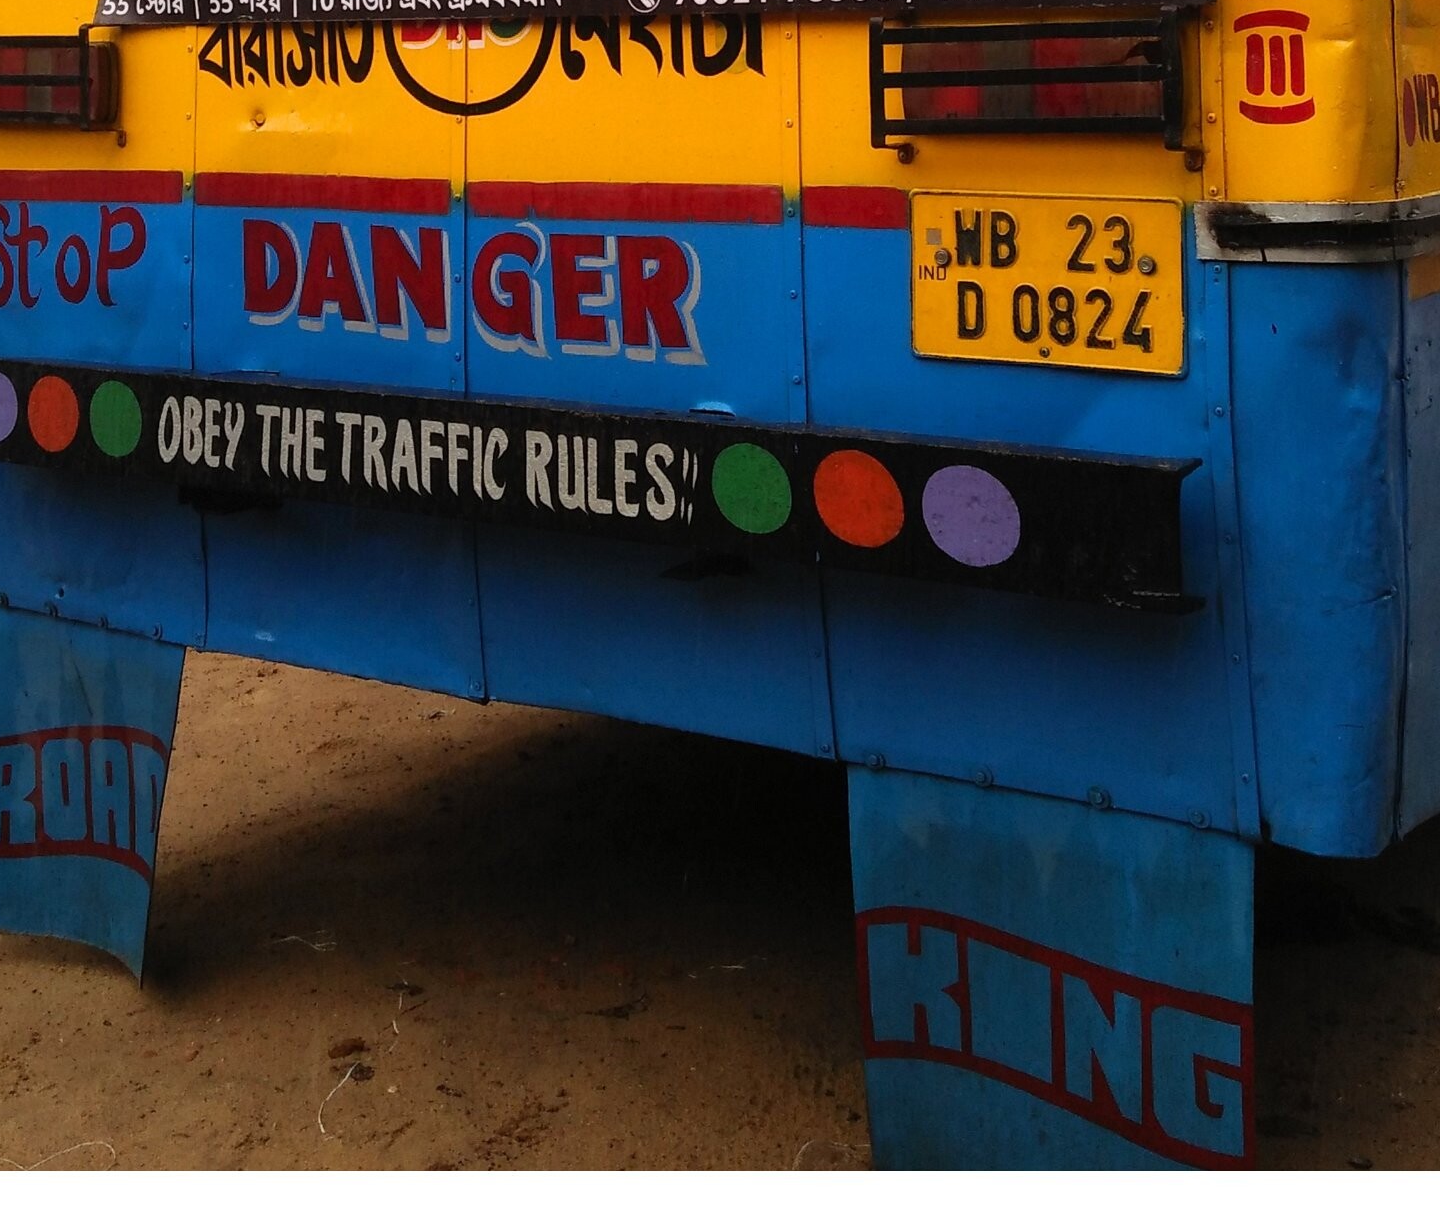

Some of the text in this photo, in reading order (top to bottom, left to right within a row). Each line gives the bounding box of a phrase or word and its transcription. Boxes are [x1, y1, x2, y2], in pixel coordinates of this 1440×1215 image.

[242, 219, 706, 364] DANGER
[954, 209, 1134, 274] WB 23
[957, 281, 1153, 353] D 0824
[158, 396, 244, 471] OBEY
[256, 404, 326, 482] THE
[335, 412, 509, 501] TRAFFIC
[866, 922, 1245, 1158] KING
